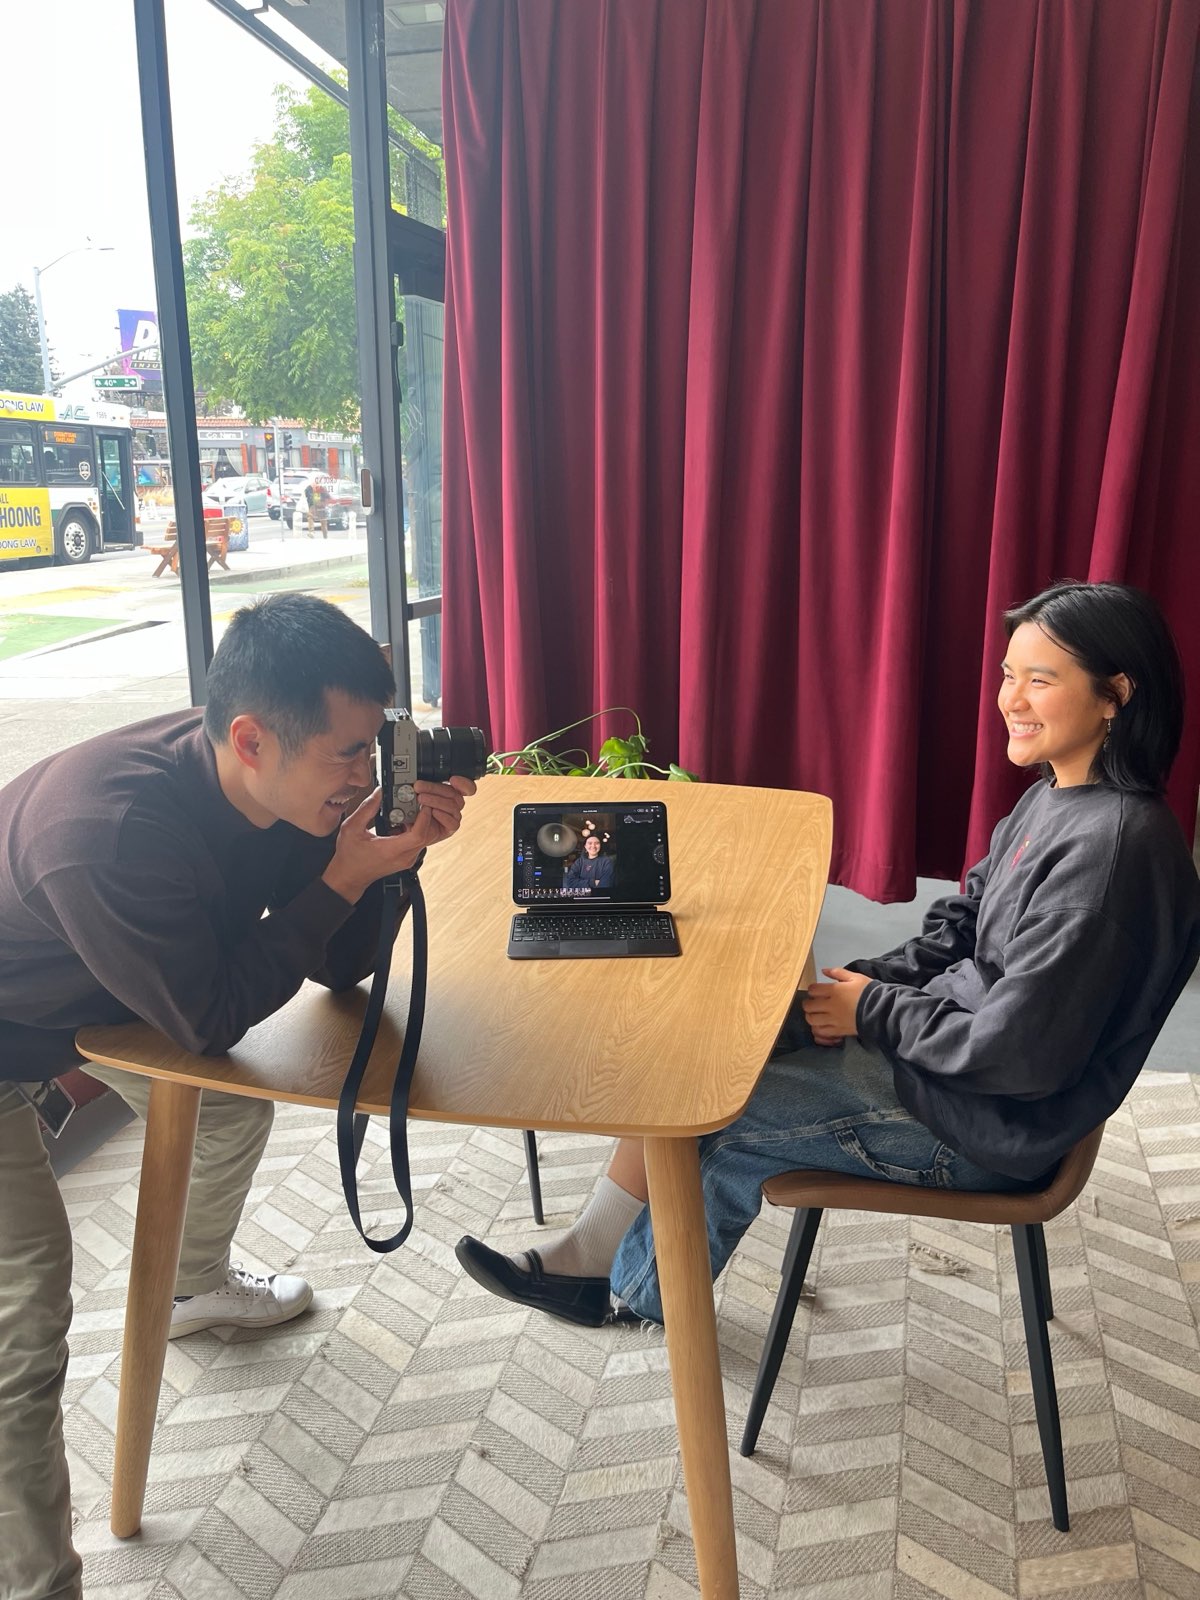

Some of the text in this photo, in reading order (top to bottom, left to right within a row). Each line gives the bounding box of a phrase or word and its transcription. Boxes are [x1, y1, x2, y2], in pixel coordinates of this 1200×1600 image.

[25, 401, 44, 412] LAW
[0, 506, 41, 528] HOONG
[0, 539, 36, 549] ONG LAW
